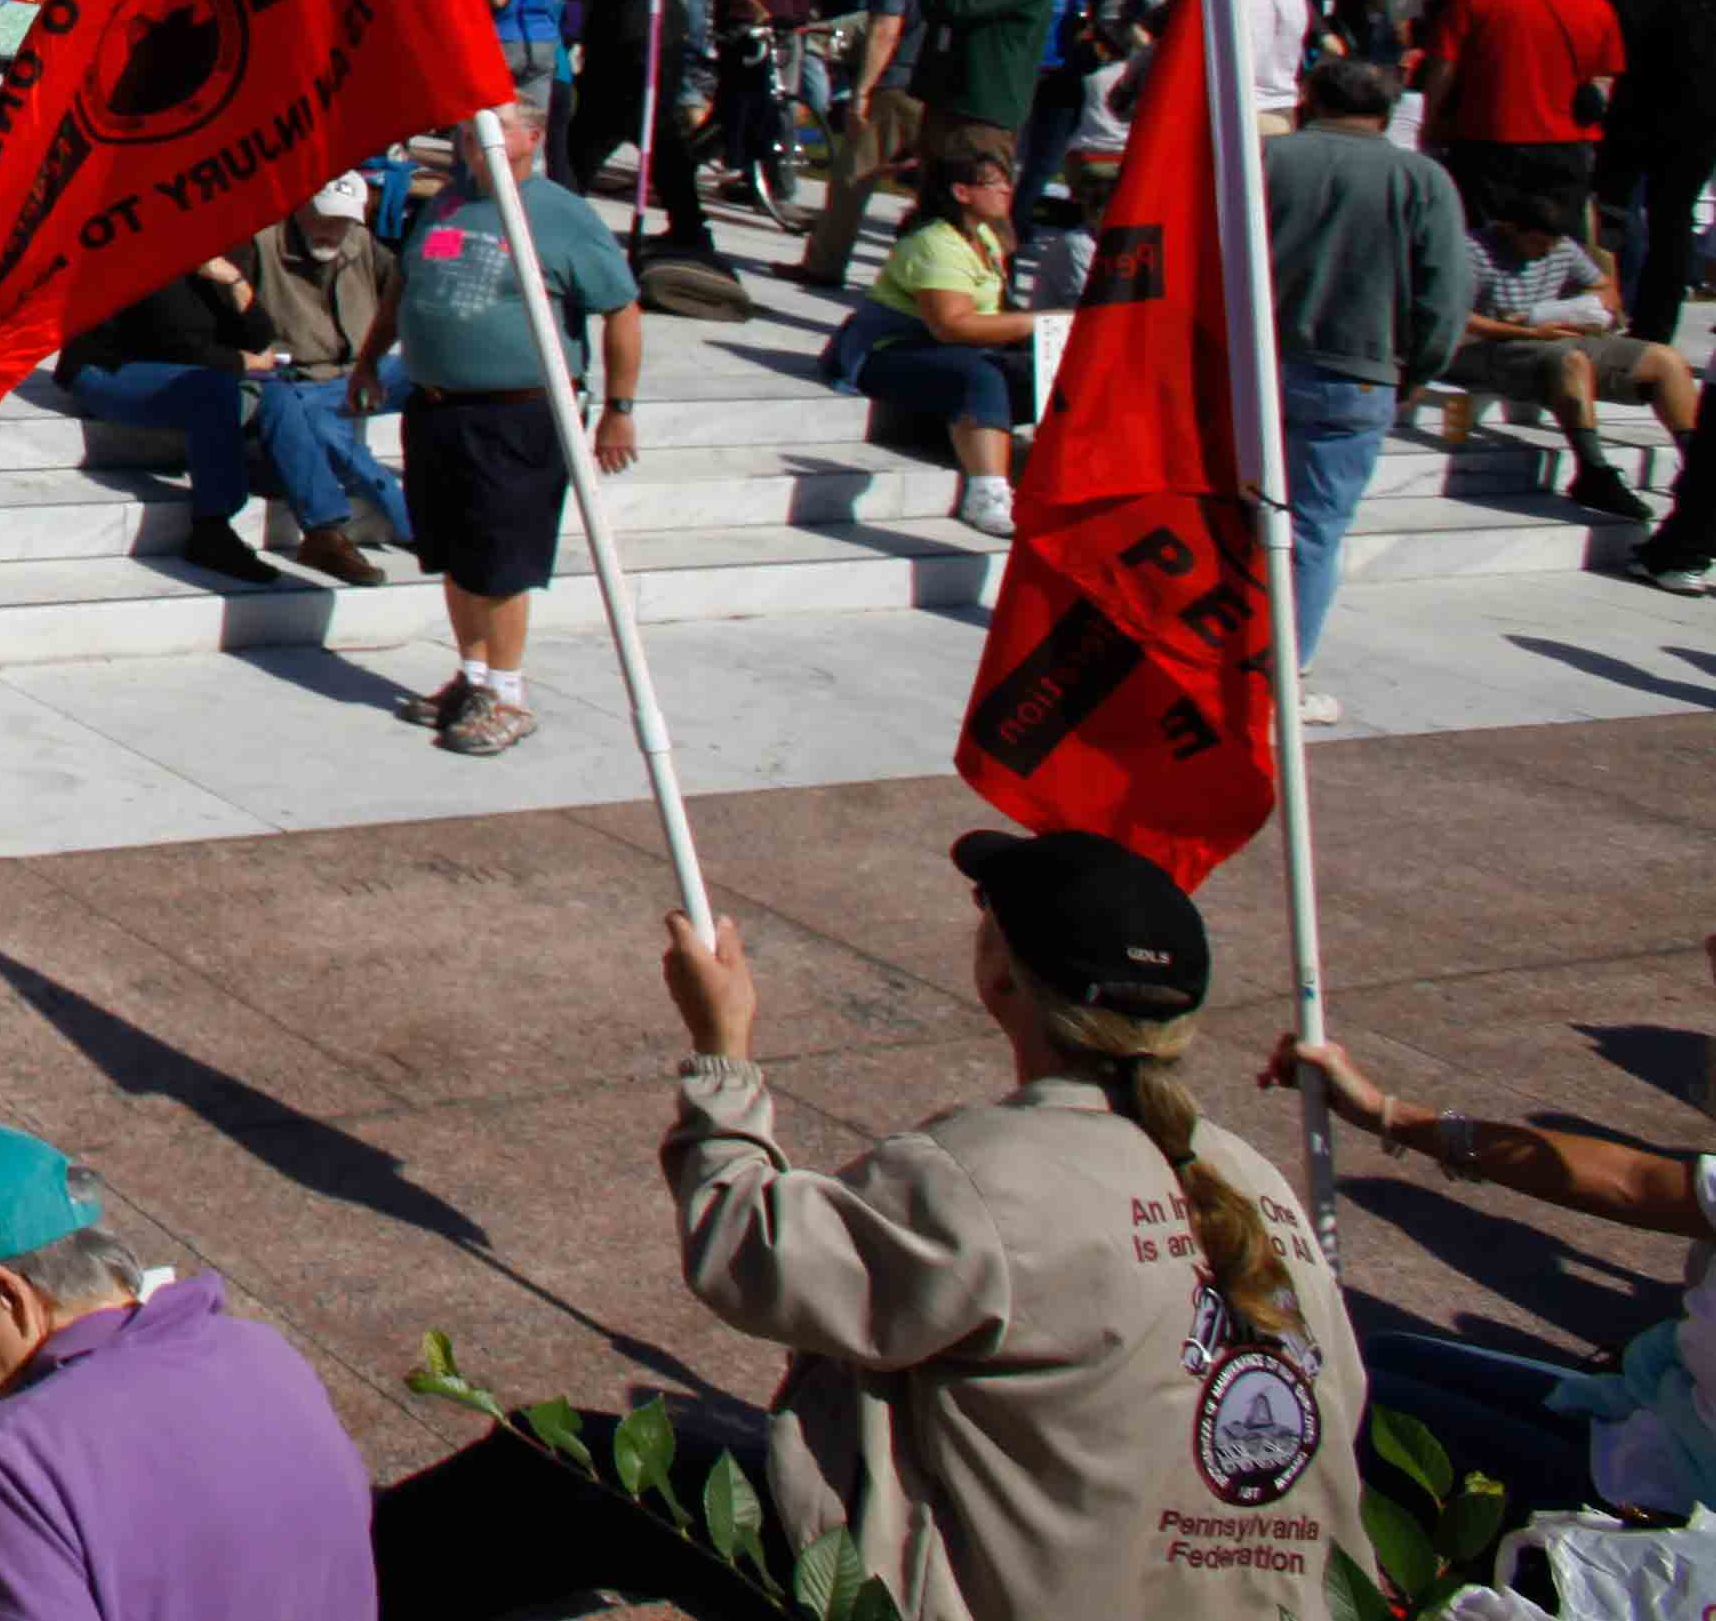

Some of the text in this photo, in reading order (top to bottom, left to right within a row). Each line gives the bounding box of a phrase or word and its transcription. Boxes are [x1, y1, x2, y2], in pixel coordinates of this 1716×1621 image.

[1130, 1196, 1167, 1227] An
[1259, 1194, 1299, 1229] One
[1132, 1235, 1159, 1264] Is
[1168, 1233, 1196, 1258] an
[1271, 1236, 1287, 1257] o
[1160, 1509, 1321, 1543] Pennsylvania
[1166, 1539, 1306, 1575] Federation
